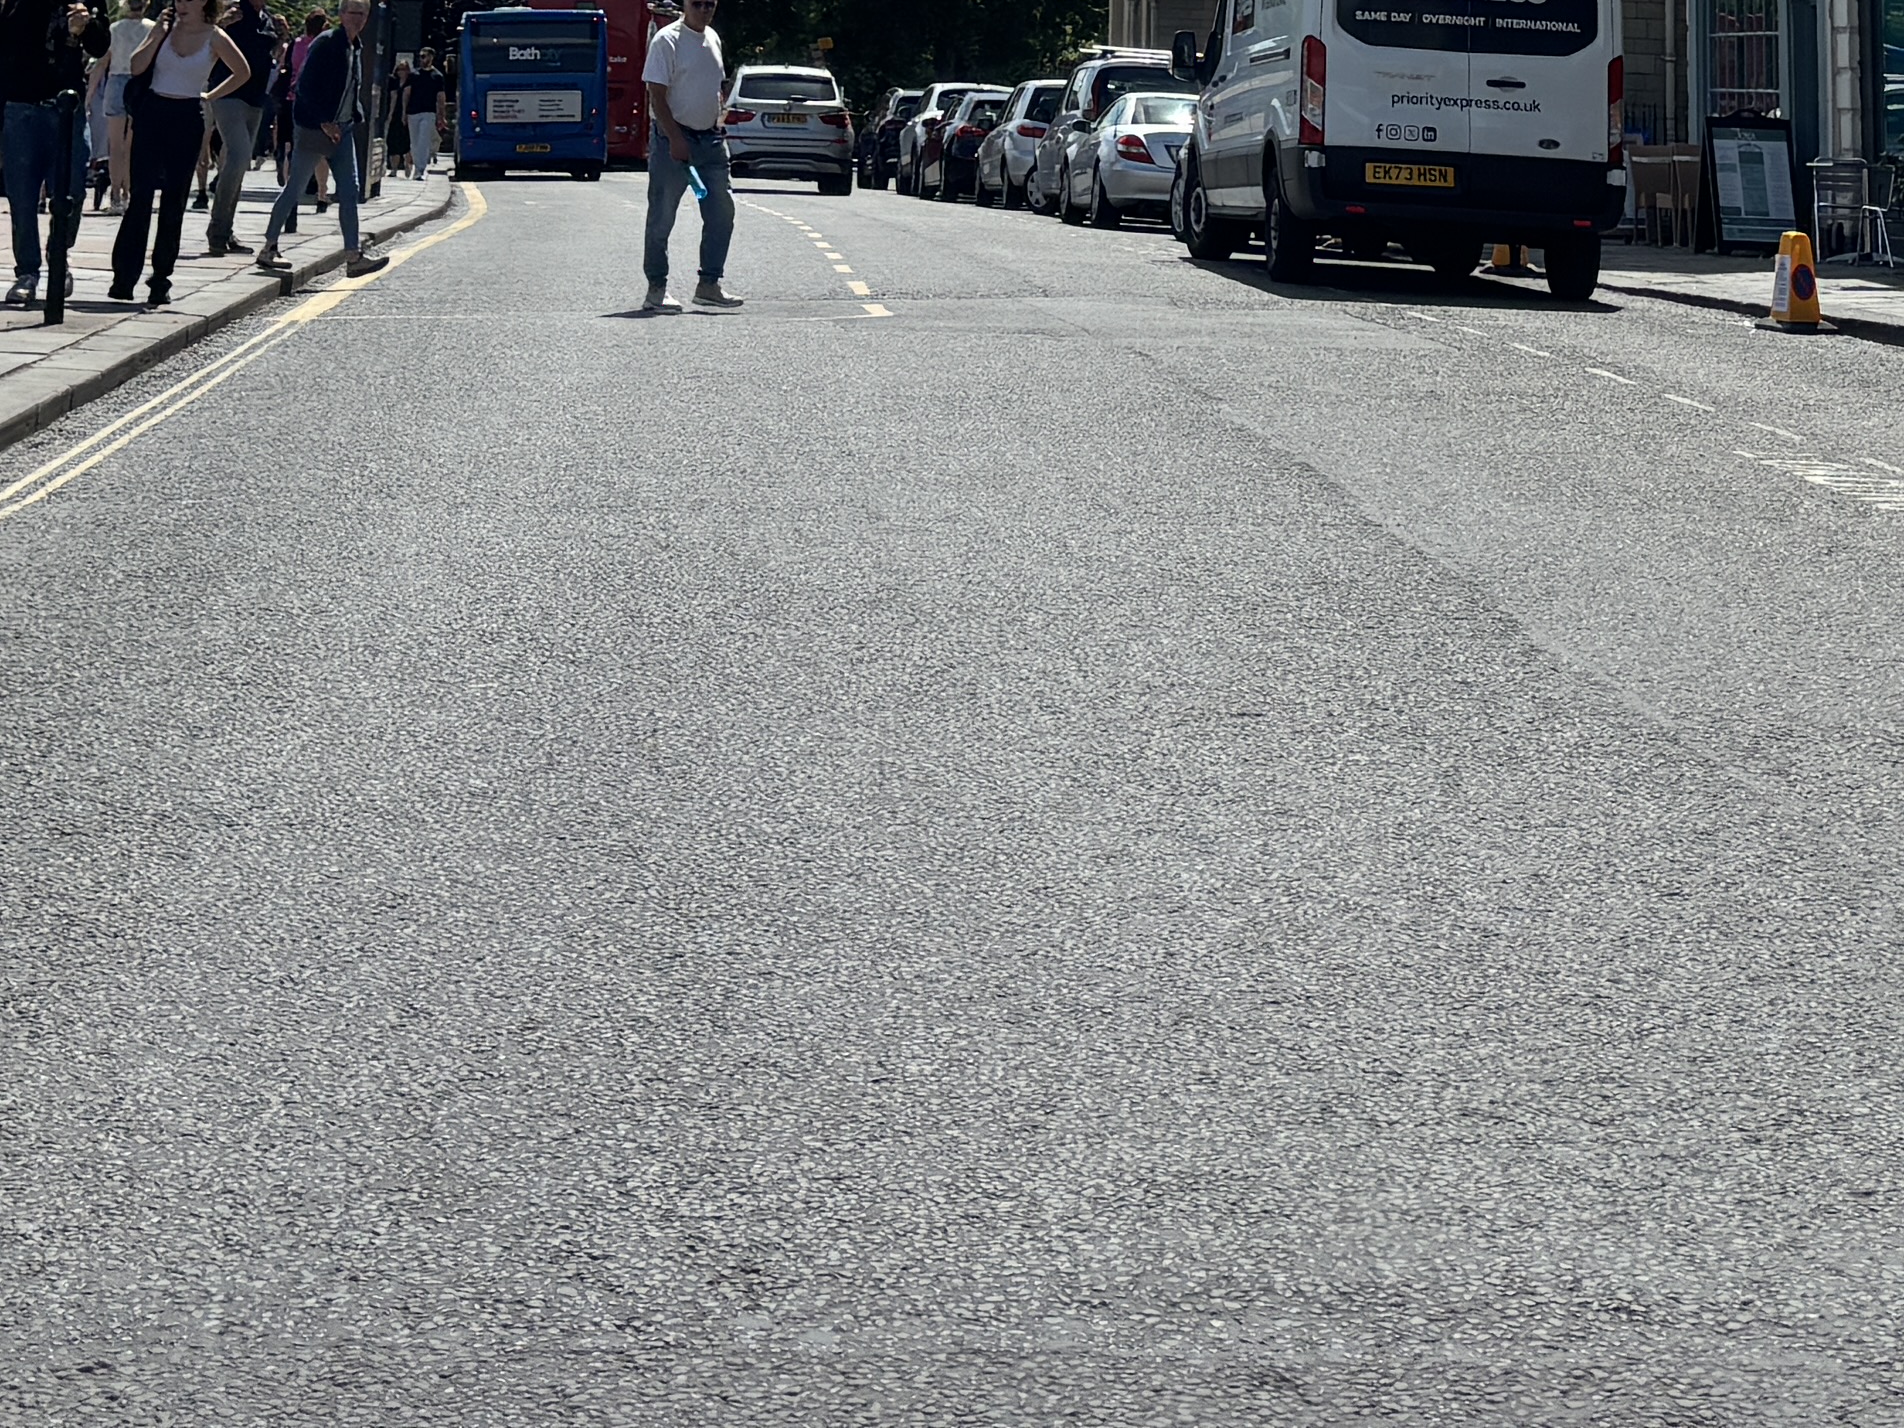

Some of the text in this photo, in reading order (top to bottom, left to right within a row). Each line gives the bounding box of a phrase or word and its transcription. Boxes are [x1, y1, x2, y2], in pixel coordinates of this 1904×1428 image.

[1355, 10, 1581, 33] SAME DAY OVERNIGHT INTERNATIONAL
[1391, 91, 1542, 113] priorityexpress.co.uk
[1372, 164, 1448, 183] EK73 HSN
